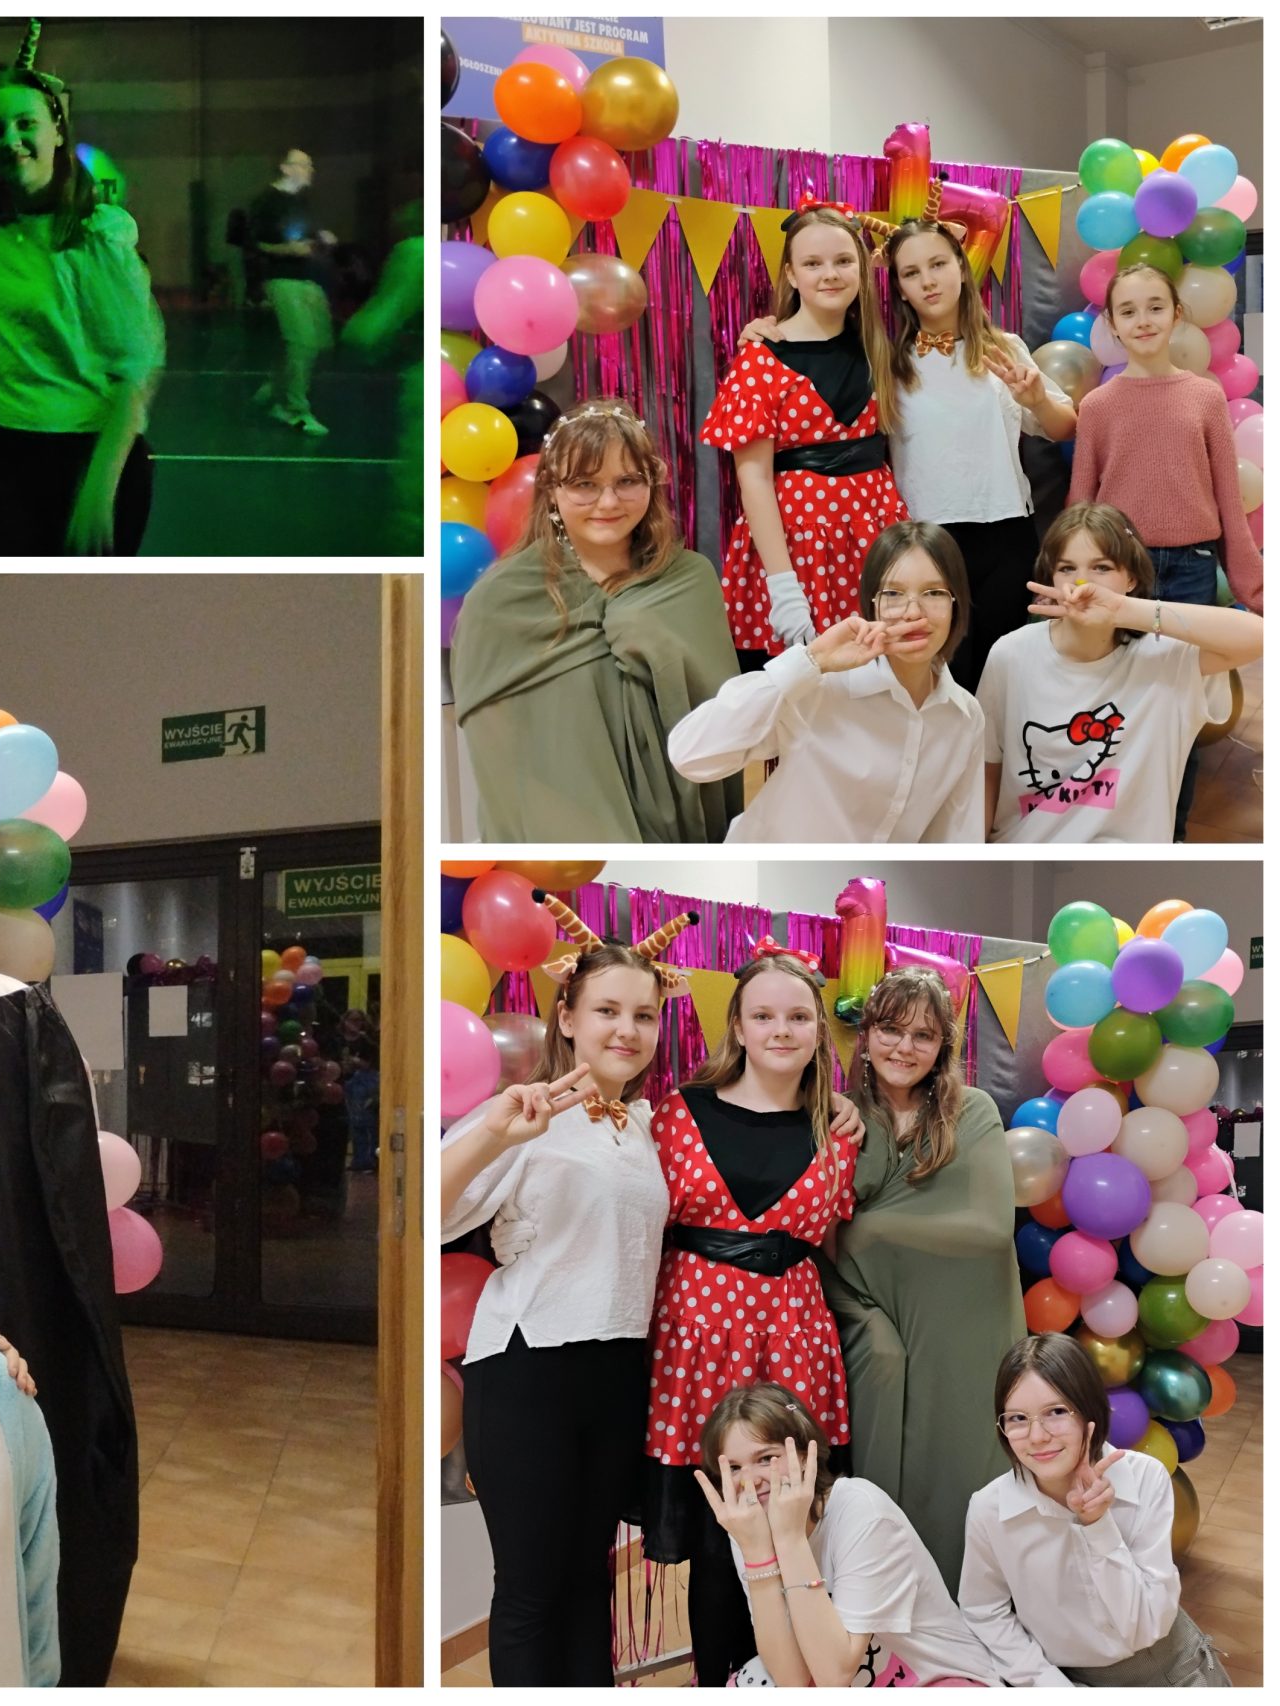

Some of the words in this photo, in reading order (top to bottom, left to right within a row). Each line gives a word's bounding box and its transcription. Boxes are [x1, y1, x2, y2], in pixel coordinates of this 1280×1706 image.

[574, 19, 596, 34] JEST
[598, 23, 649, 44] PROGRAM
[164, 723, 223, 740] WYJŚCIE
[294, 872, 381, 894] WYJŚCIE
